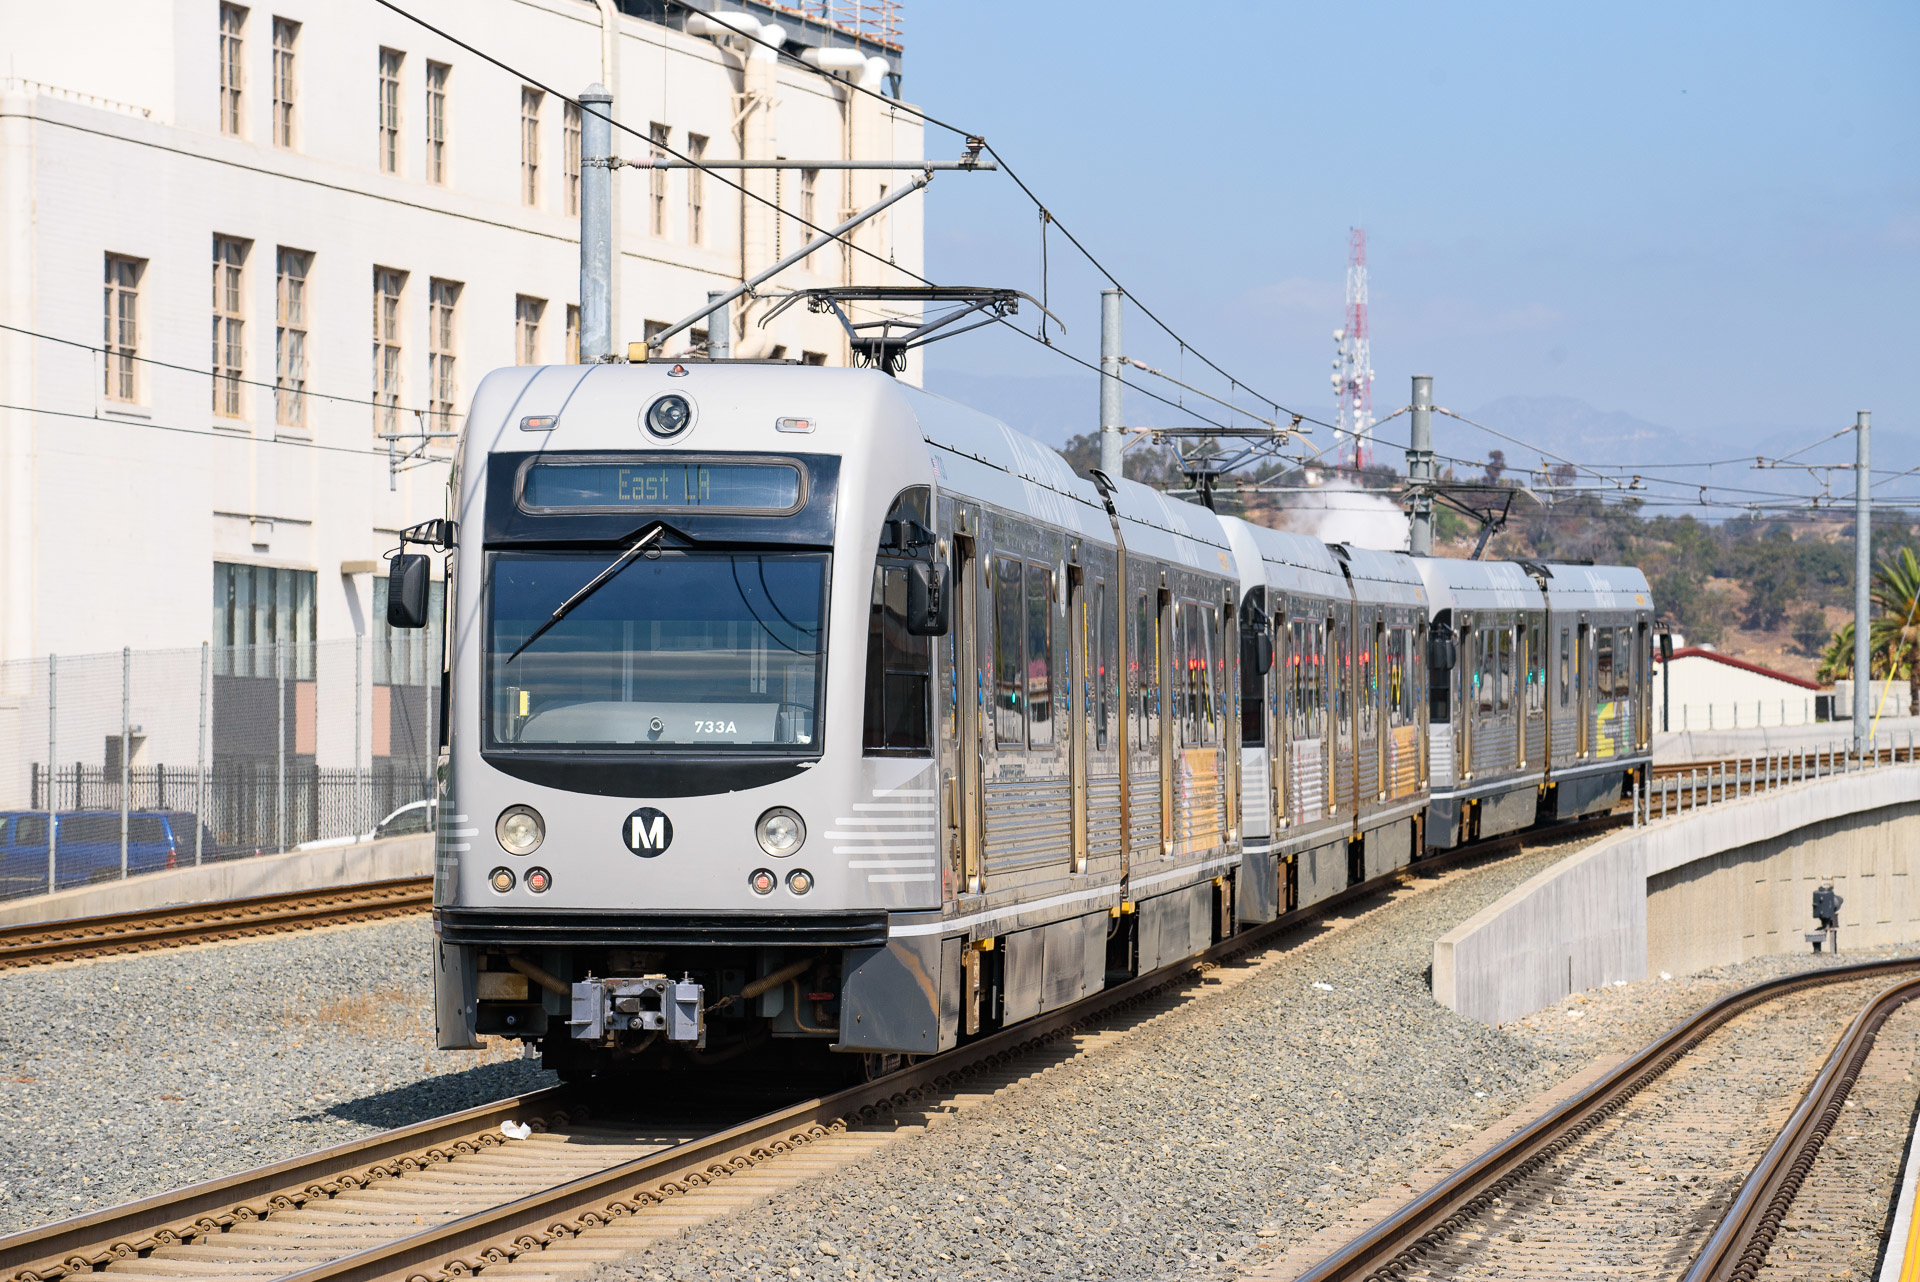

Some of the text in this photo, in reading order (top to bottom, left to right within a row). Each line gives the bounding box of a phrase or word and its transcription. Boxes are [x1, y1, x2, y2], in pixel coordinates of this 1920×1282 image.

[619, 469, 709, 500] East LA
[694, 720, 737, 734] 733A
[631, 816, 664, 849] M
